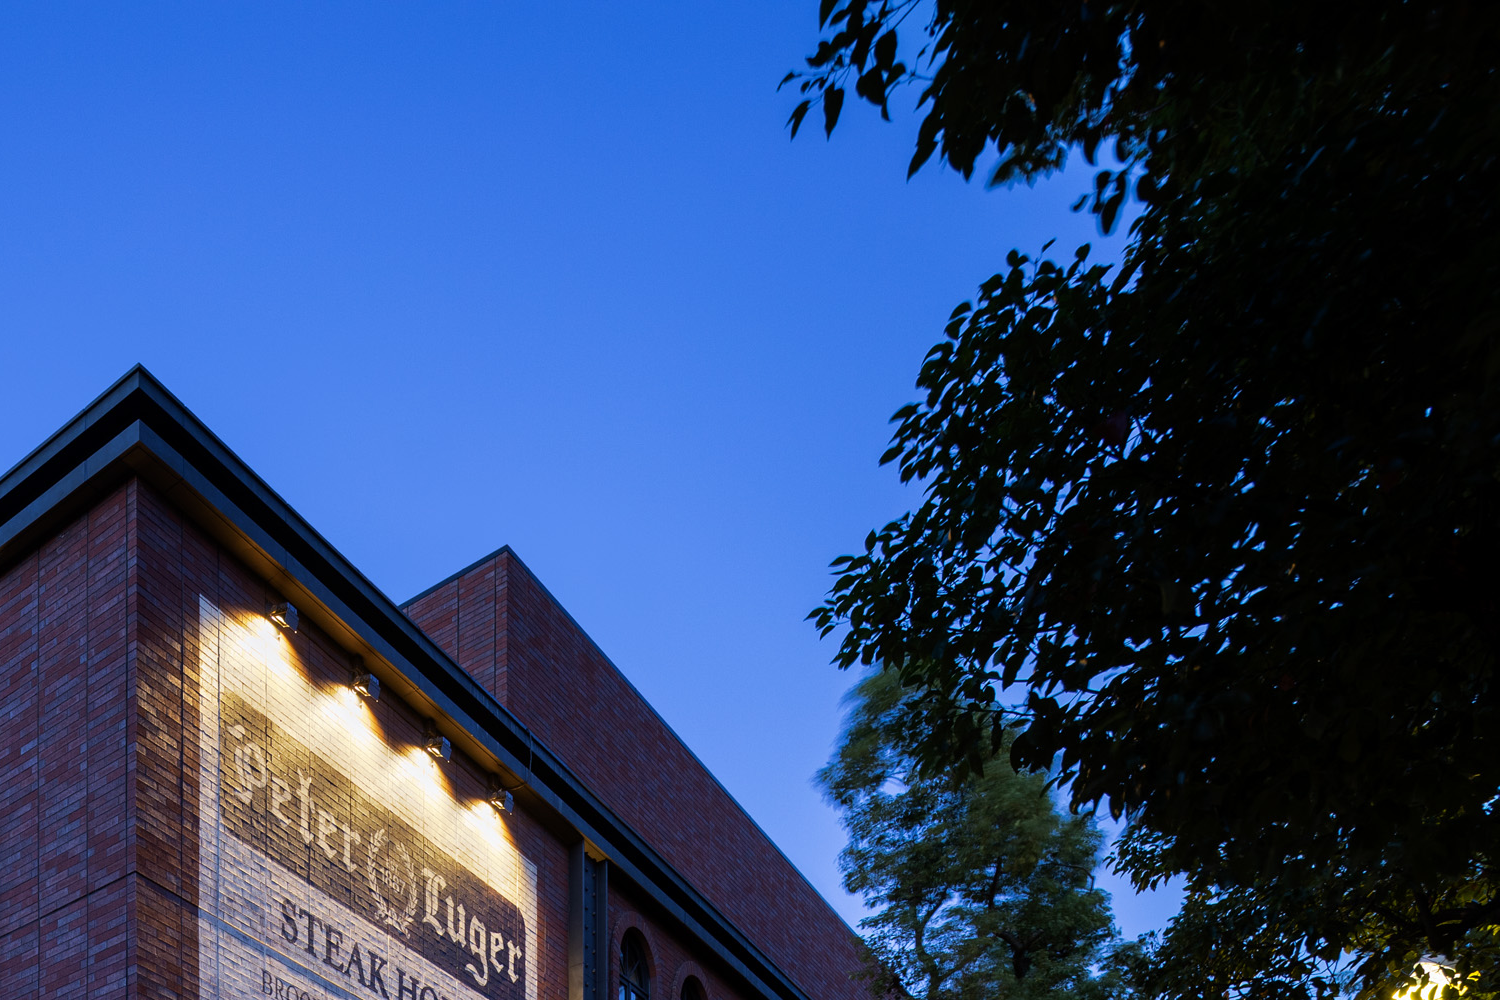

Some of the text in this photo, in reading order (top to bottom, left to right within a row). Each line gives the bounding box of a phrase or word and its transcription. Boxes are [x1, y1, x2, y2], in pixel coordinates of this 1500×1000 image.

[226, 724, 523, 987] Peter Luger
[380, 867, 406, 895] 1887
[281, 899, 390, 1000] STEAK
